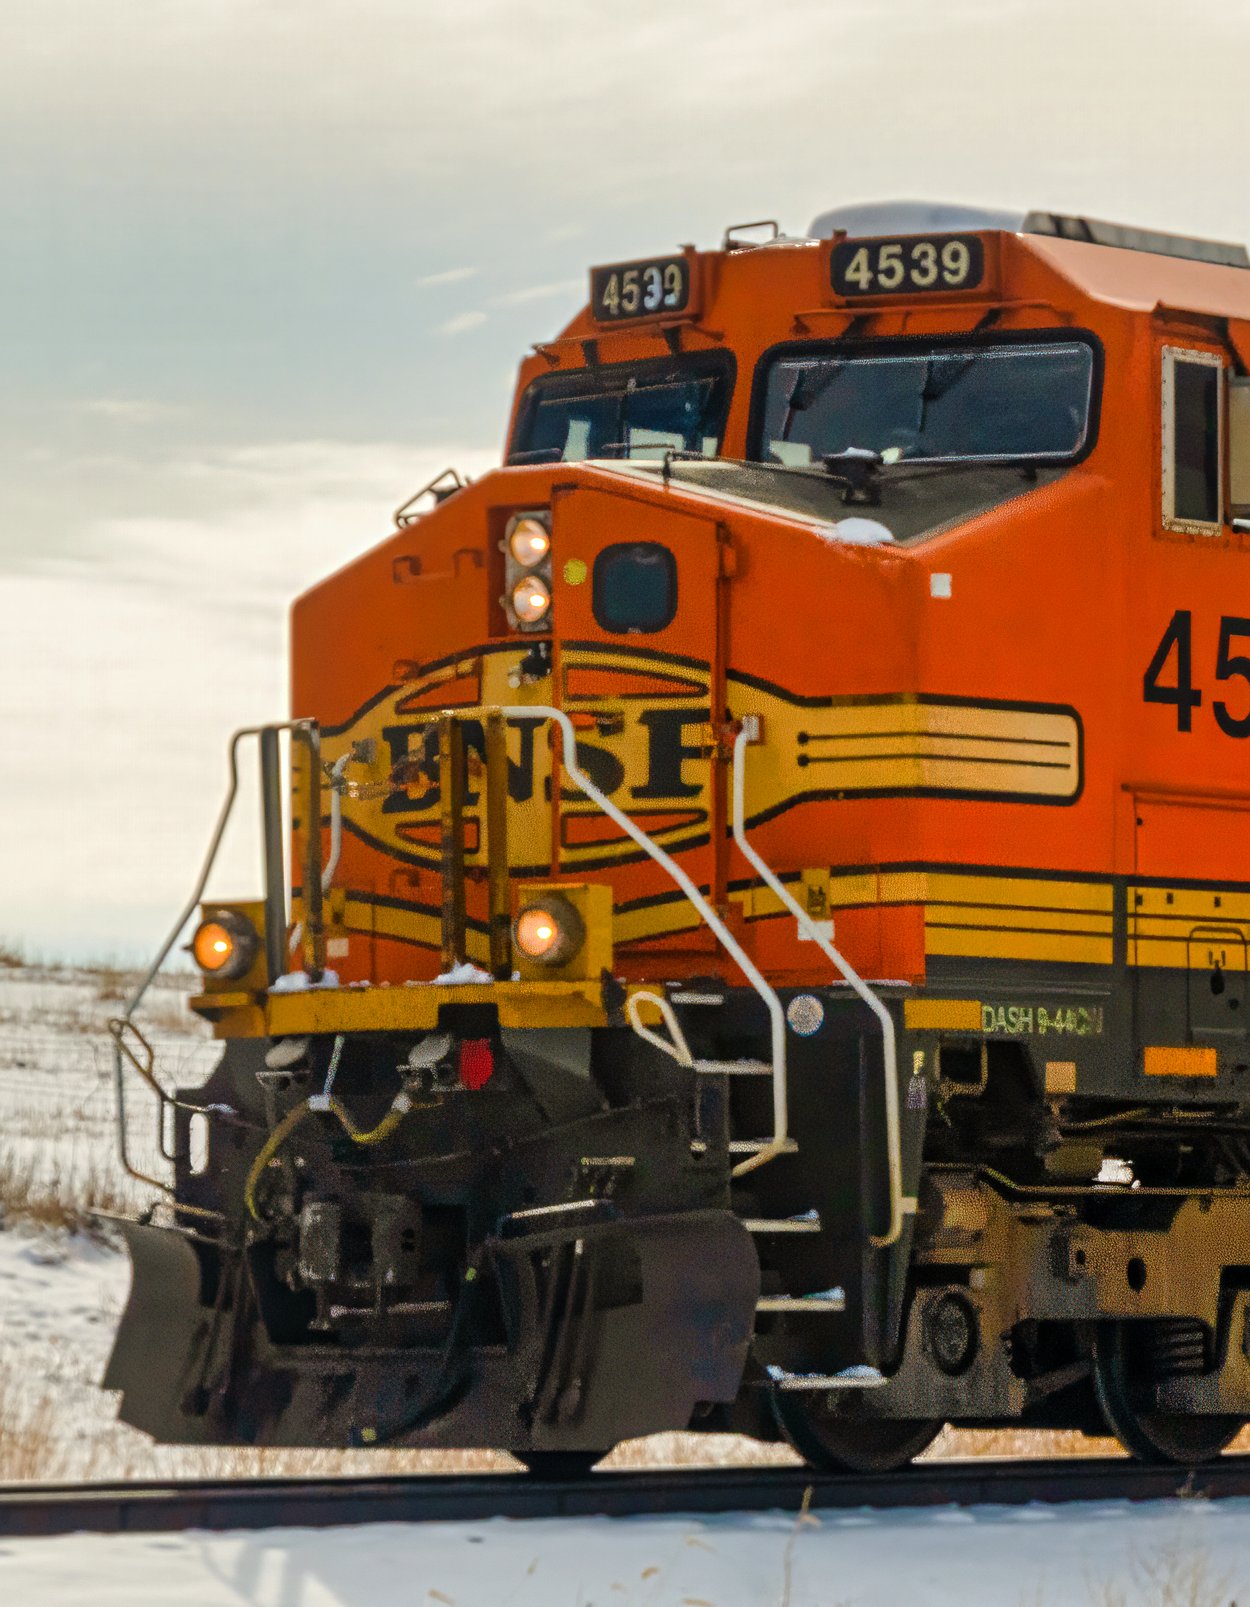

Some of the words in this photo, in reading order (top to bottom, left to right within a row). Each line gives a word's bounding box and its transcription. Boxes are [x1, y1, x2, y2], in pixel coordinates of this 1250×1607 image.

[602, 263, 682, 316] 4539
[842, 240, 971, 291] 4539
[982, 1005, 1034, 1034] DASH
